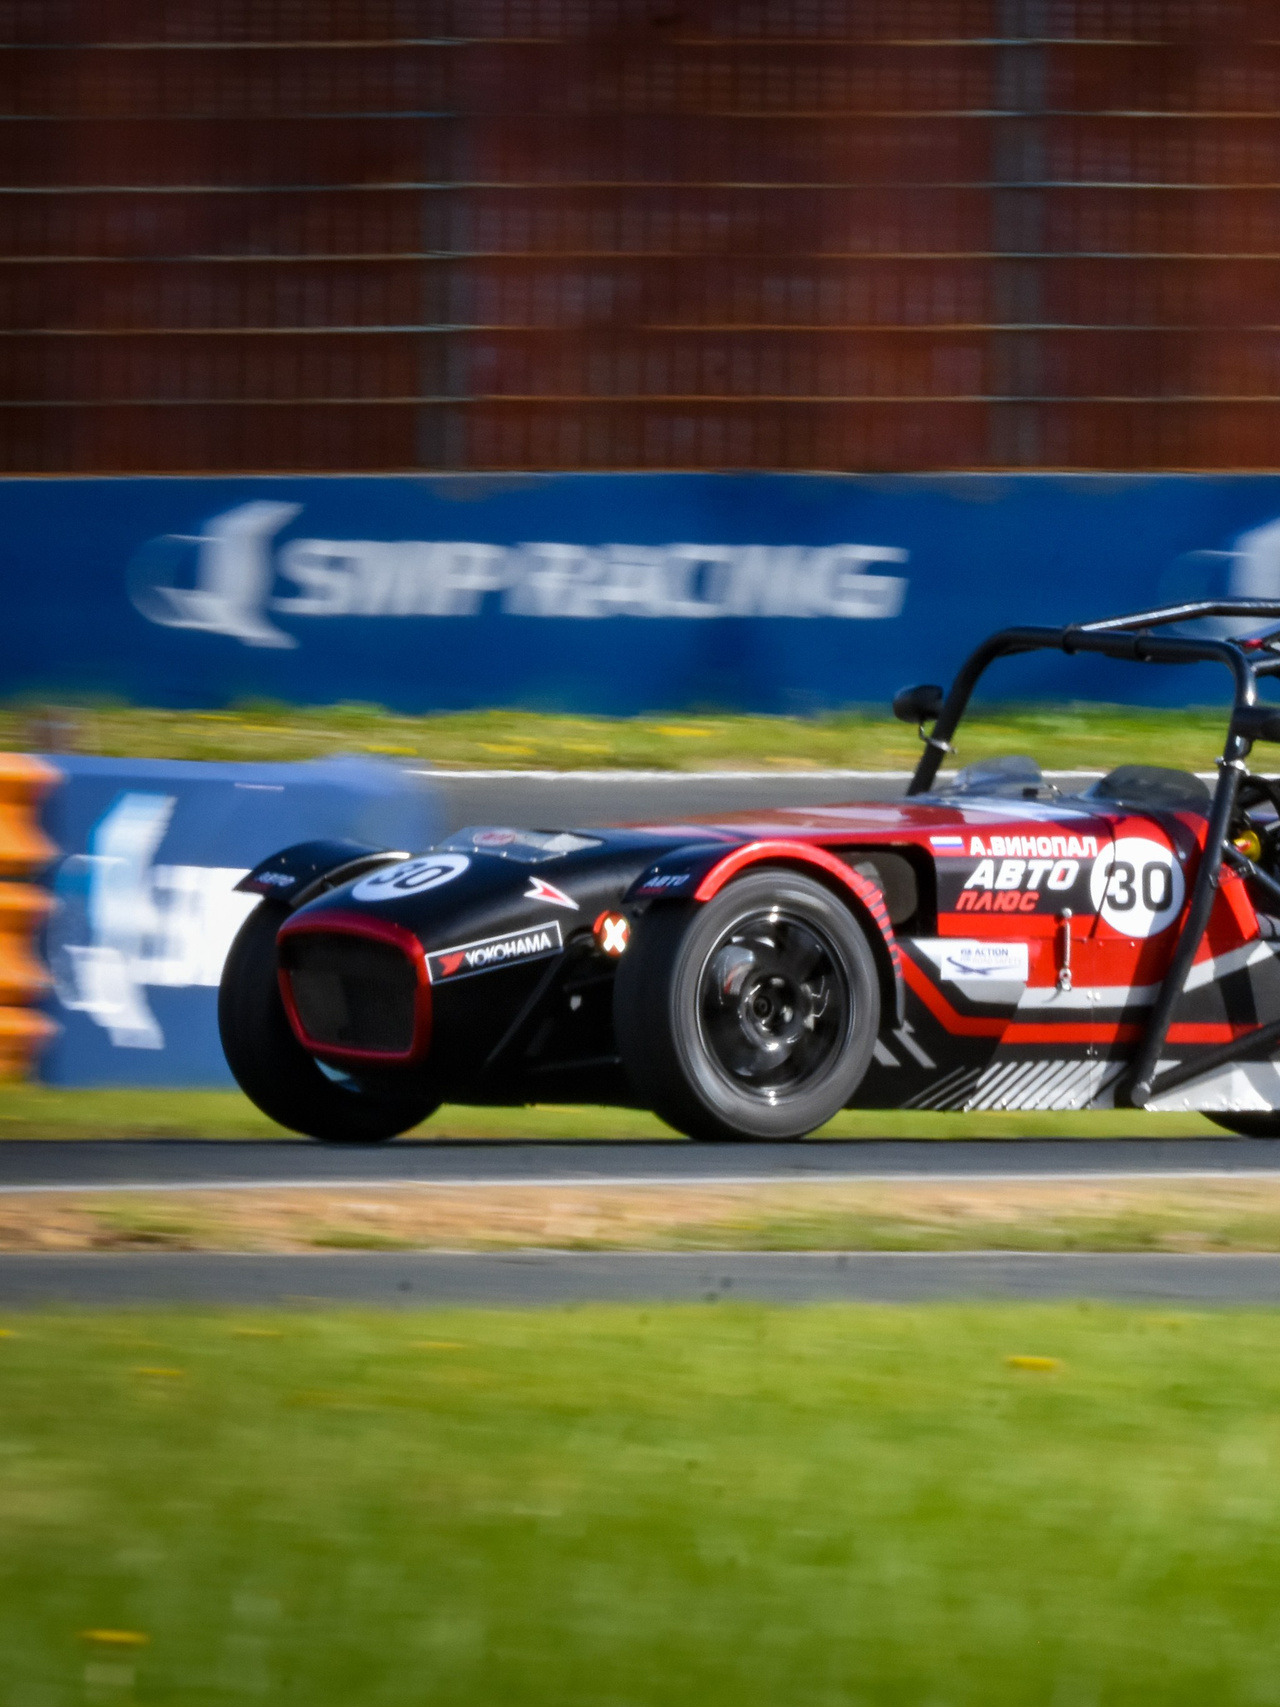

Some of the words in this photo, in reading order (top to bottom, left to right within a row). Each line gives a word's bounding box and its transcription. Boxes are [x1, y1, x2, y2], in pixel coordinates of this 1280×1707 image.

[274, 539, 506, 616] SMP
[502, 542, 908, 618] RACING
[970, 836, 1098, 857] А.ВИНОПАЛ
[366, 861, 455, 889] 30
[964, 859, 1080, 890] АВТО
[1104, 861, 1174, 912] 30
[956, 891, 1040, 912] ПЛЮС
[465, 931, 551, 967] YOKOHAMA
[975, 948, 1009, 956] ACTION
